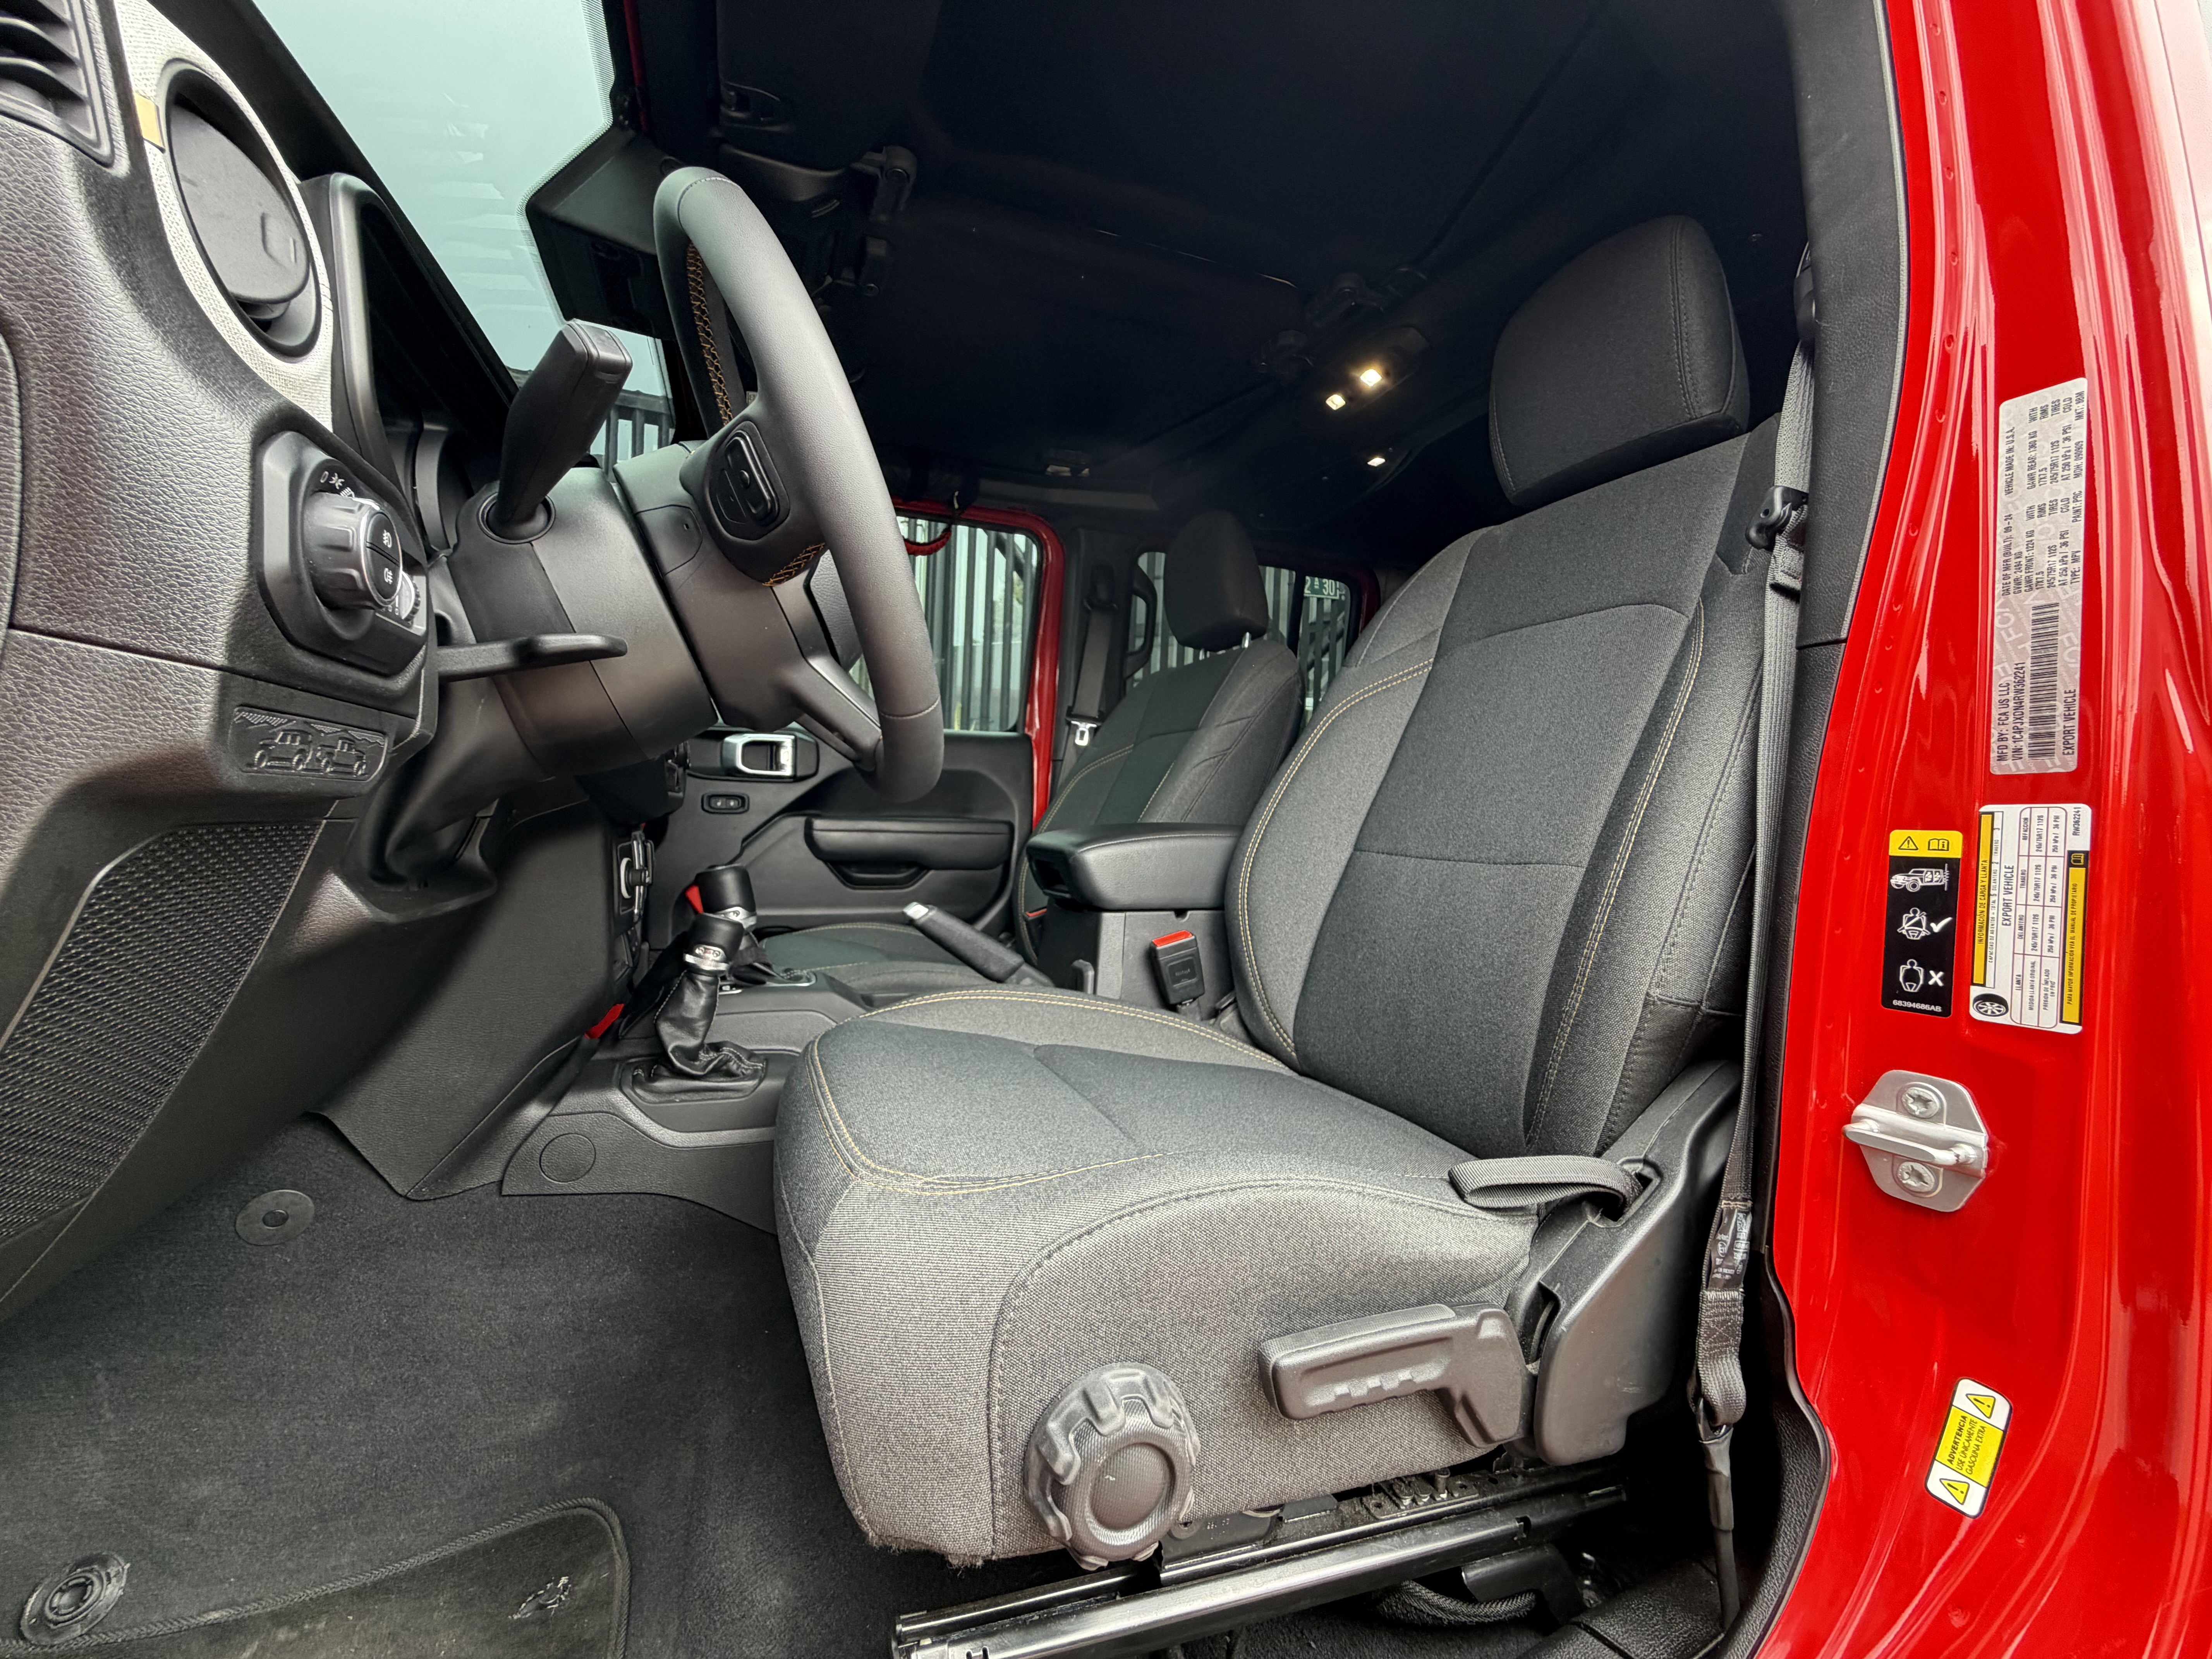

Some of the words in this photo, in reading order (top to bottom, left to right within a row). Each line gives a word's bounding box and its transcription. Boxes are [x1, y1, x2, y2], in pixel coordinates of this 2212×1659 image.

[2039, 404, 2049, 420] RIMS
[2051, 398, 2060, 417] TIRES
[2063, 396, 2072, 414] COLD
[2074, 404, 2084, 421] MKT:
[2028, 406, 2038, 423] WITH
[2005, 426, 2015, 445] U.S.A.
[2028, 430, 2037, 440] KG
[2062, 424, 2072, 435] PSI
[2005, 445, 2014, 454] IN:
[2028, 439, 2037, 453] 1360
[2050, 439, 2059, 454] 112S
[2073, 440, 2083, 462] 090909
[2005, 454, 2014, 472] MADE
[2027, 452, 2037, 471] REAR:
[2061, 449, 2071, 461] kPa
[2049, 454, 2059, 484] 245/75R17
[2061, 461, 2071, 472] 250
[2073, 461, 2083, 479] MDH:
[2004, 471, 2014, 495] VEHICLE
[2027, 471, 2036, 490] GAWR
[2038, 467, 2047, 487] 17X7.5
[2061, 472, 2071, 482] AT
[2026, 504, 2035, 521] WITH
[2037, 502, 2046, 519] RIMS
[2048, 498, 2058, 516] TIRES
[2060, 496, 2070, 513] COLD
[2025, 529, 2035, 538] KG
[2059, 529, 2069, 540] PSI
[2002, 534, 2014, 558] (BUILT):
[2025, 539, 2034, 552] 1224
[2047, 544, 2057, 558] 112S
[2059, 540, 2069, 549] 36
[2014, 551, 2023, 560] KG
[2058, 555, 2068, 566] kPa
[2071, 549, 2081, 563] MPV
[2002, 558, 2011, 572] MFR
[2013, 560, 2023, 574] 2494
[2046, 558, 2056, 589] 245/75R17
[2058, 566, 2068, 577] 250
[2002, 572, 2011, 580] OF
[2024, 574, 2033, 592] GAWR
[2035, 570, 2044, 590] 17X7.5
[2058, 578, 2068, 587] AT
[2070, 566, 2080, 584] TYPE:
[1322, 578, 1335, 596] 30
[2002, 580, 2011, 596] DATE
[2013, 575, 2022, 594] GVWR:
[1998, 682, 2010, 696] LLC
[1997, 698, 2010, 709] US
[2011, 661, 2025, 744] 1C4PJXDN4RW362241
[2063, 689, 2076, 722] VEHICLE
[1997, 711, 2009, 726] FCA
[1997, 728, 2009, 742] BY:
[2062, 724, 2075, 756] EXPORT
[1996, 744, 2009, 762] MFD
[2011, 744, 2023, 761] VIN:
[2072, 807, 2081, 836] RW362241
[2002, 864, 2014, 895] VEHICLE
[2001, 897, 2013, 926] EXPORT
[1947, 1415, 1967, 1465] ADVERTENCIA
[1958, 1419, 1978, 1458] ÚNICAMENTE
[1965, 1443, 1981, 1475] GASOLINA
[1975, 1425, 1987, 1443] EXTRA
[1956, 1458, 1965, 1471] USE
